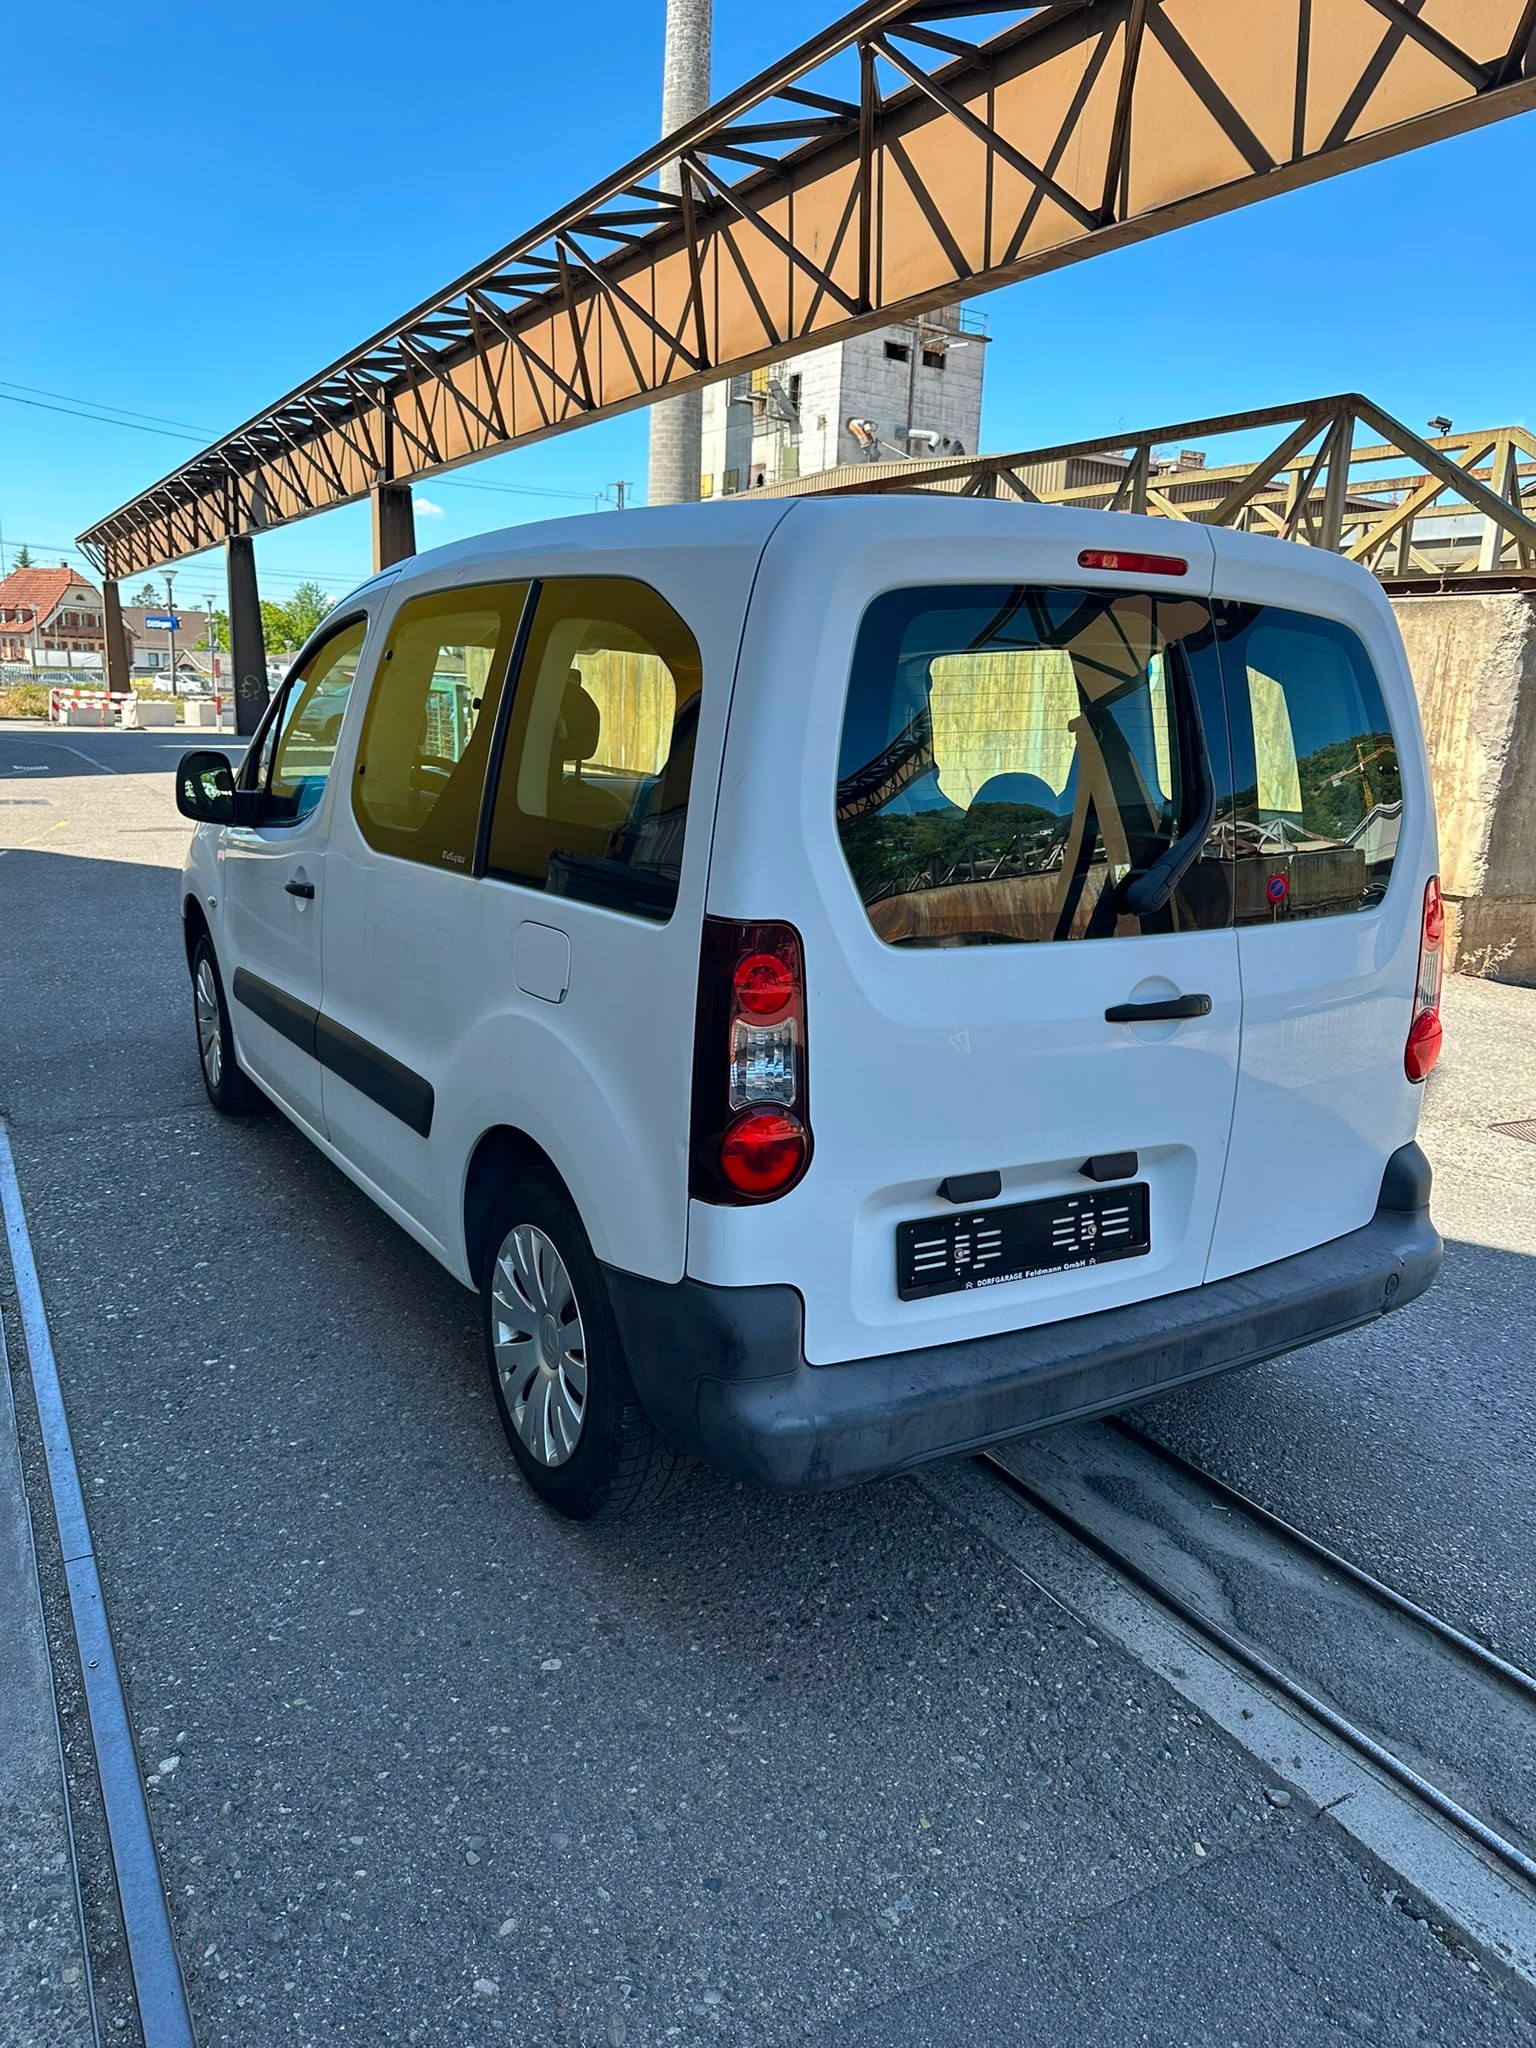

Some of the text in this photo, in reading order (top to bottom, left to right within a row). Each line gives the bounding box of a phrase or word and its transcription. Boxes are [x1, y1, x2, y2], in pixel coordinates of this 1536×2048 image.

[977, 1259, 1086, 1287] DORFGARAGE Feldmann GmbH
